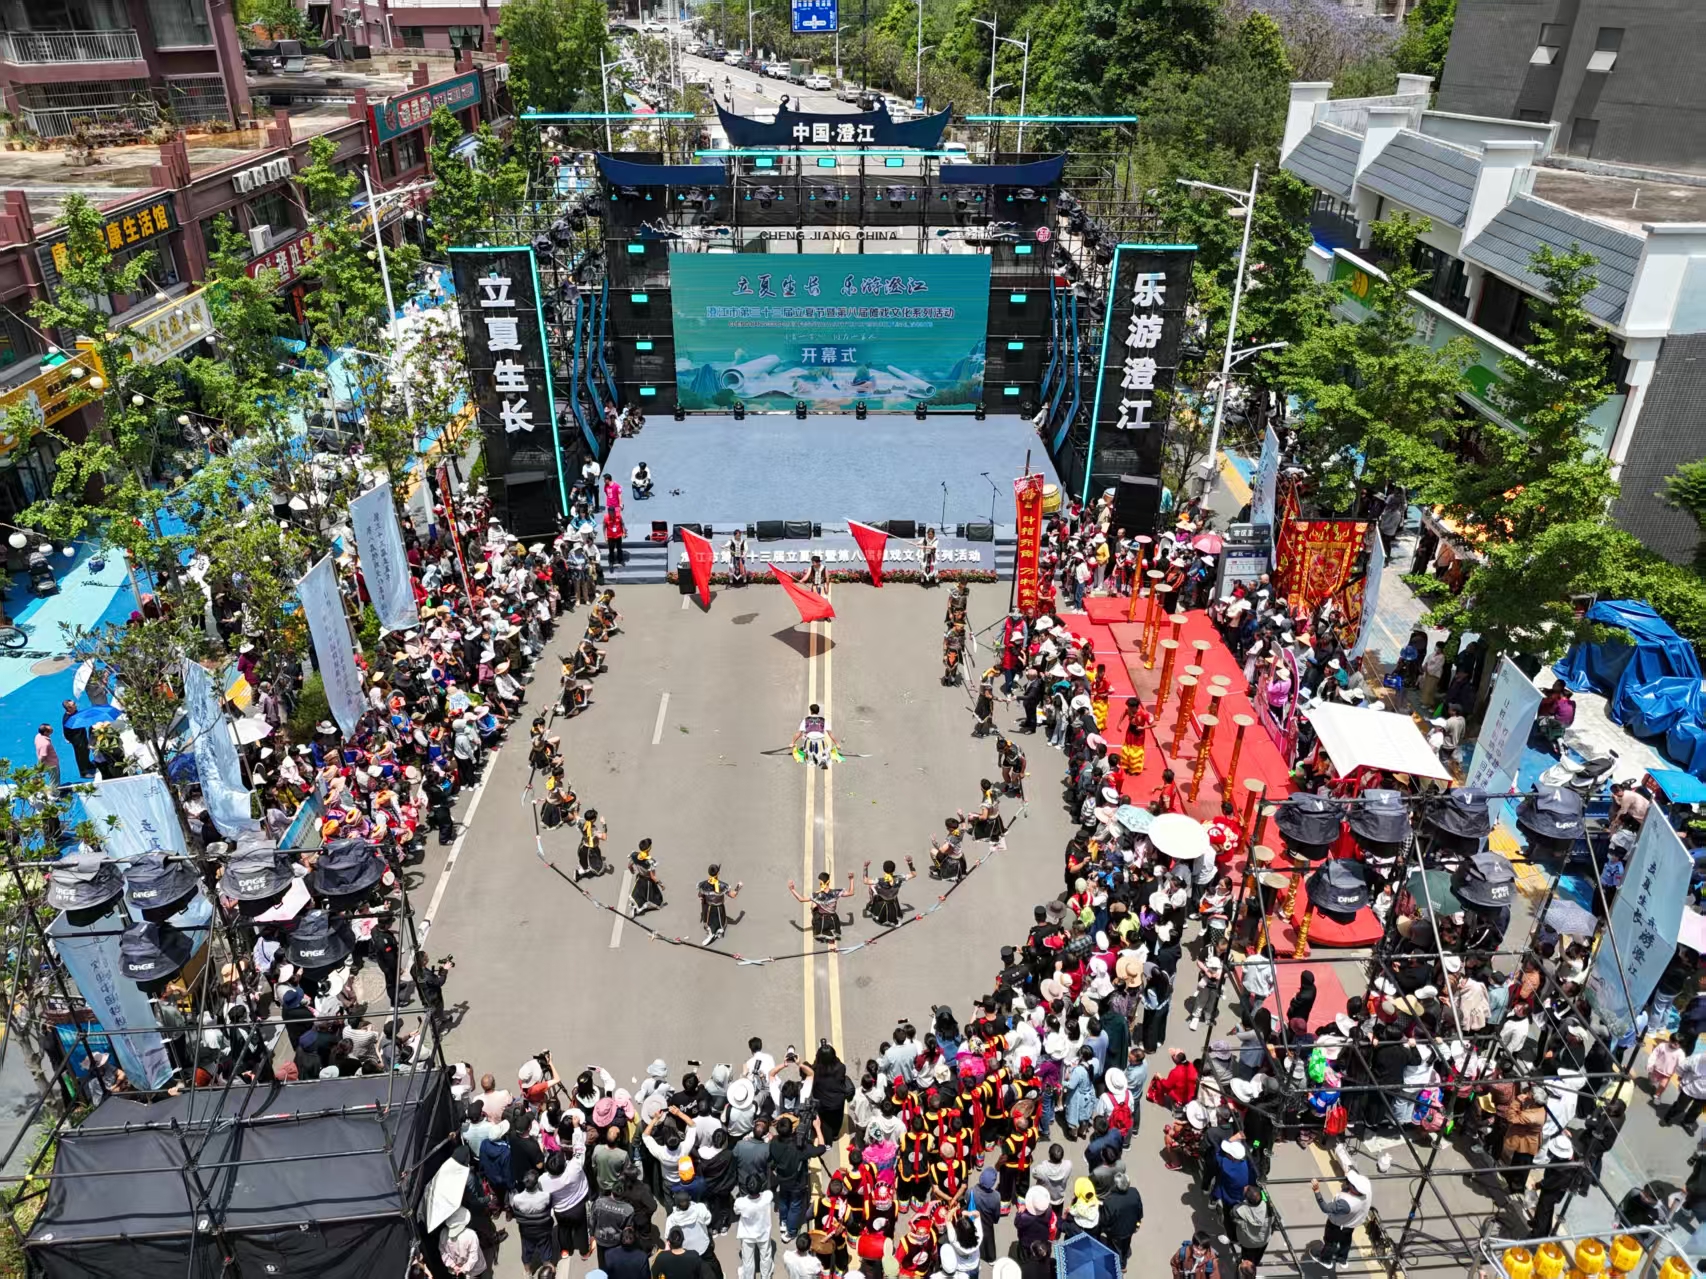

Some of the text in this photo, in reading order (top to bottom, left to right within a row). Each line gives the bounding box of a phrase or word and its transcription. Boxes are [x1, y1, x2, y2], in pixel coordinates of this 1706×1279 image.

[793, 122, 875, 142] 中国·澄江
[760, 231, 897, 241] CHENG JIANG CHINA
[732, 274, 928, 298] 立夏生长 乐游澄江
[478, 272, 535, 433] 立夏生长
[801, 347, 857, 363] 开幕式
[1116, 272, 1166, 429] 乐游澄江
